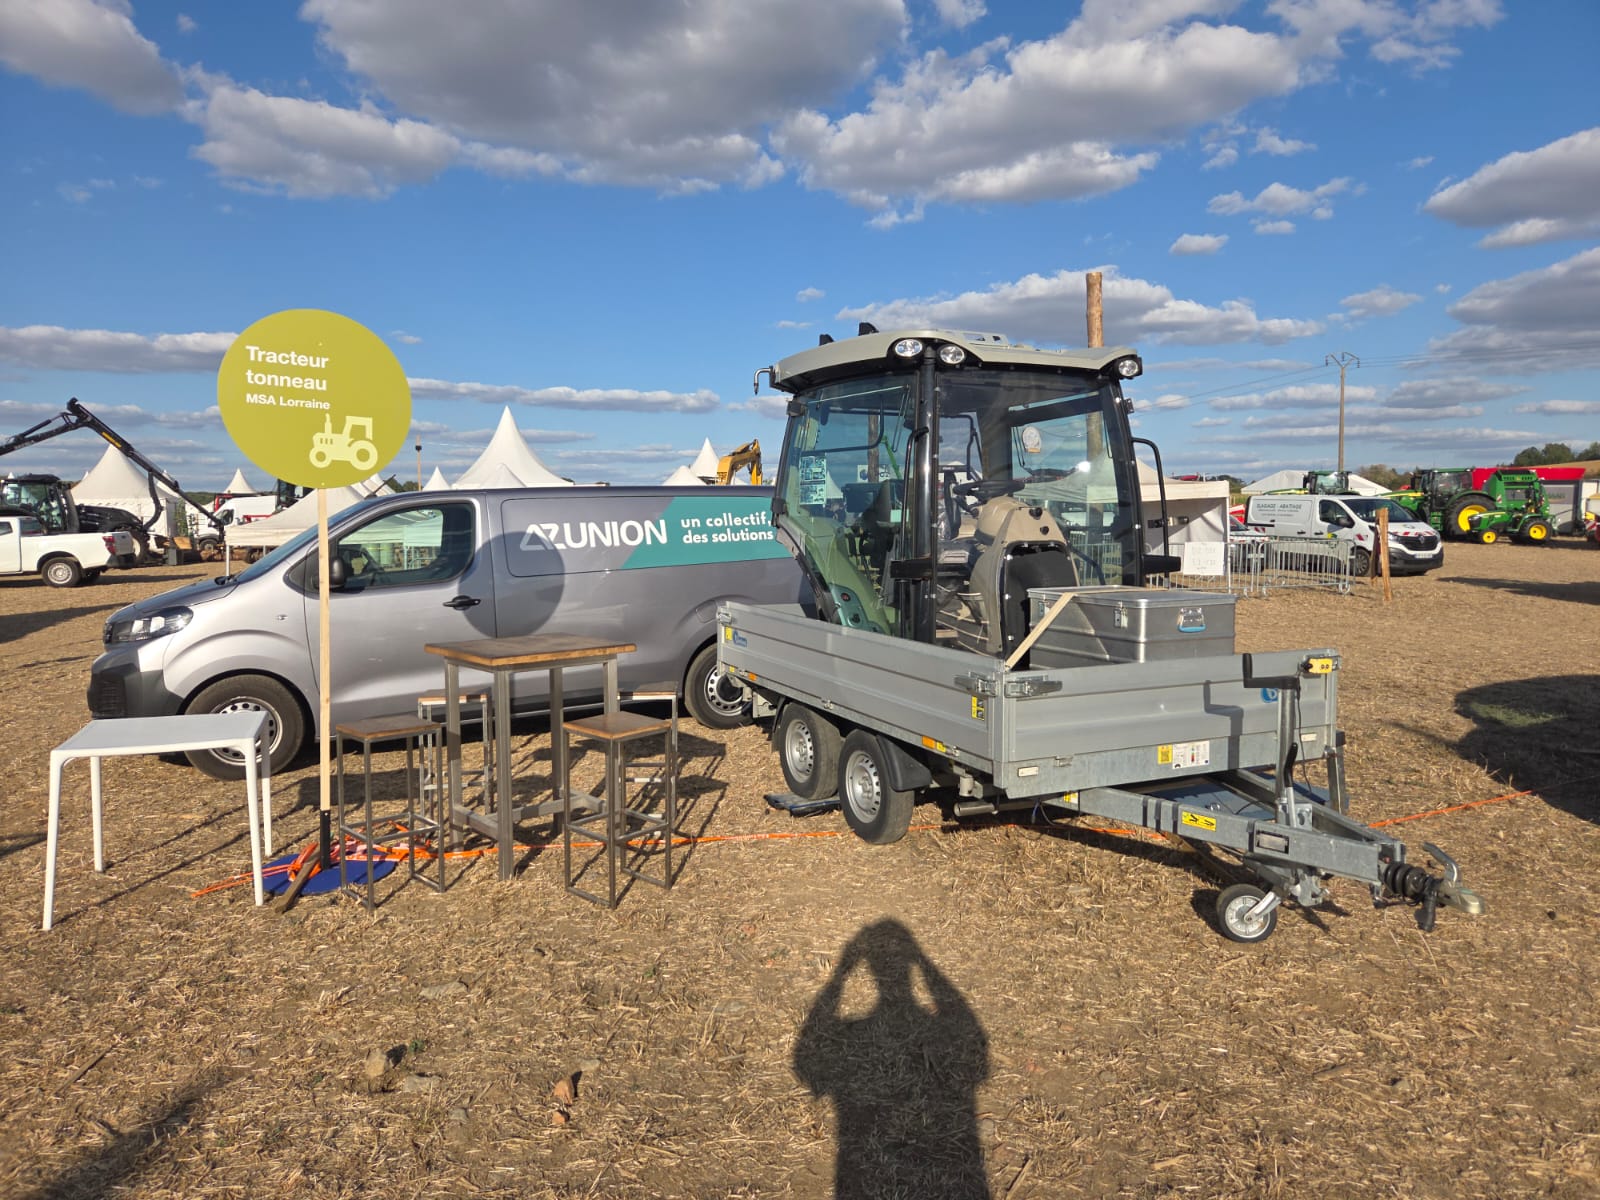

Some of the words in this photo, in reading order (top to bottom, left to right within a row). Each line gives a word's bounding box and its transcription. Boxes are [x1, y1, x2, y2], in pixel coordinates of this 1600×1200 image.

[245, 345, 329, 368] Tracteur
[245, 369, 328, 391] tonneau
[245, 393, 277, 405] MSA
[279, 396, 330, 410] Lorraine
[680, 518, 701, 528] un
[705, 511, 772, 527] collectif,
[682, 530, 709, 544] des
[711, 527, 774, 543] solutions
